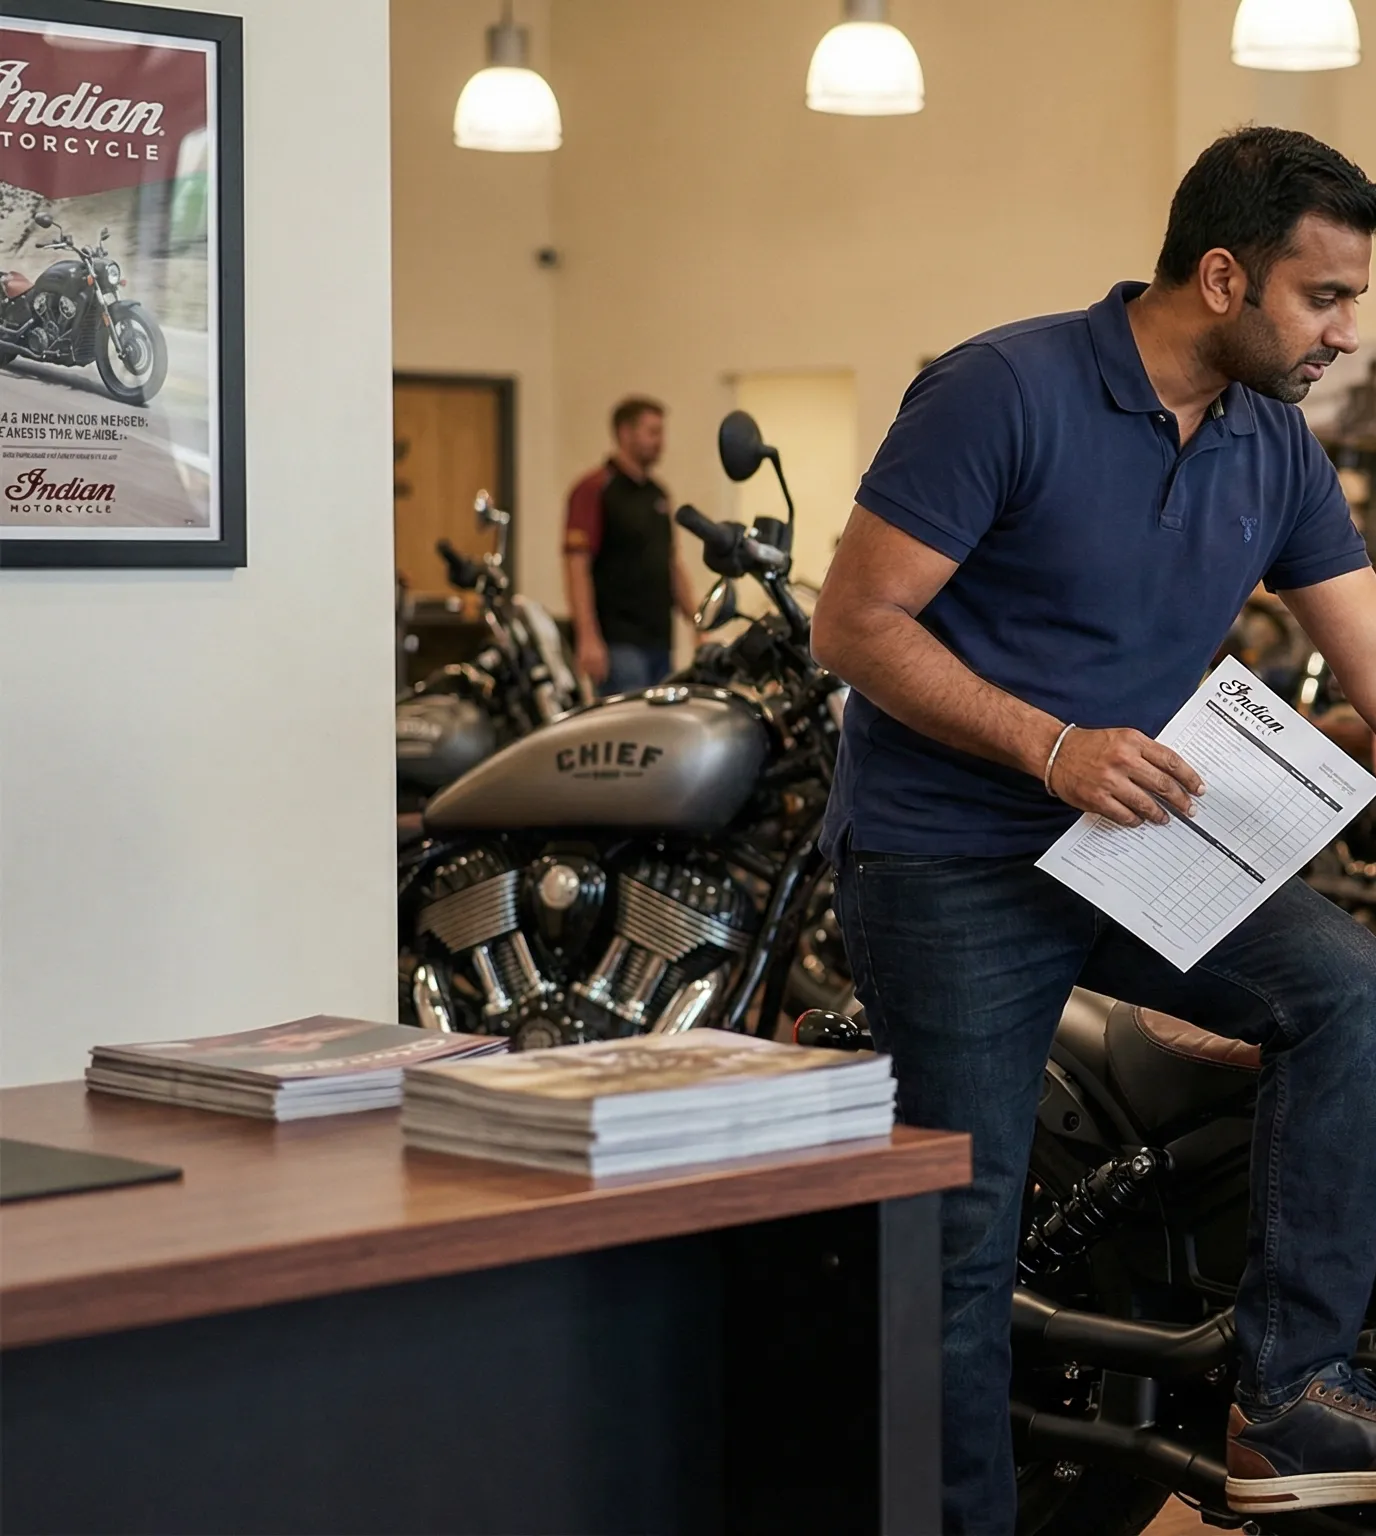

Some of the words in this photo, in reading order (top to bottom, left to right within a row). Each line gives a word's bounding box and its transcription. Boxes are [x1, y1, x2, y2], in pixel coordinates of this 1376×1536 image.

[4, 468, 116, 502] Indian
[1219, 680, 1285, 734] Indian
[556, 741, 663, 773] CHIEF
